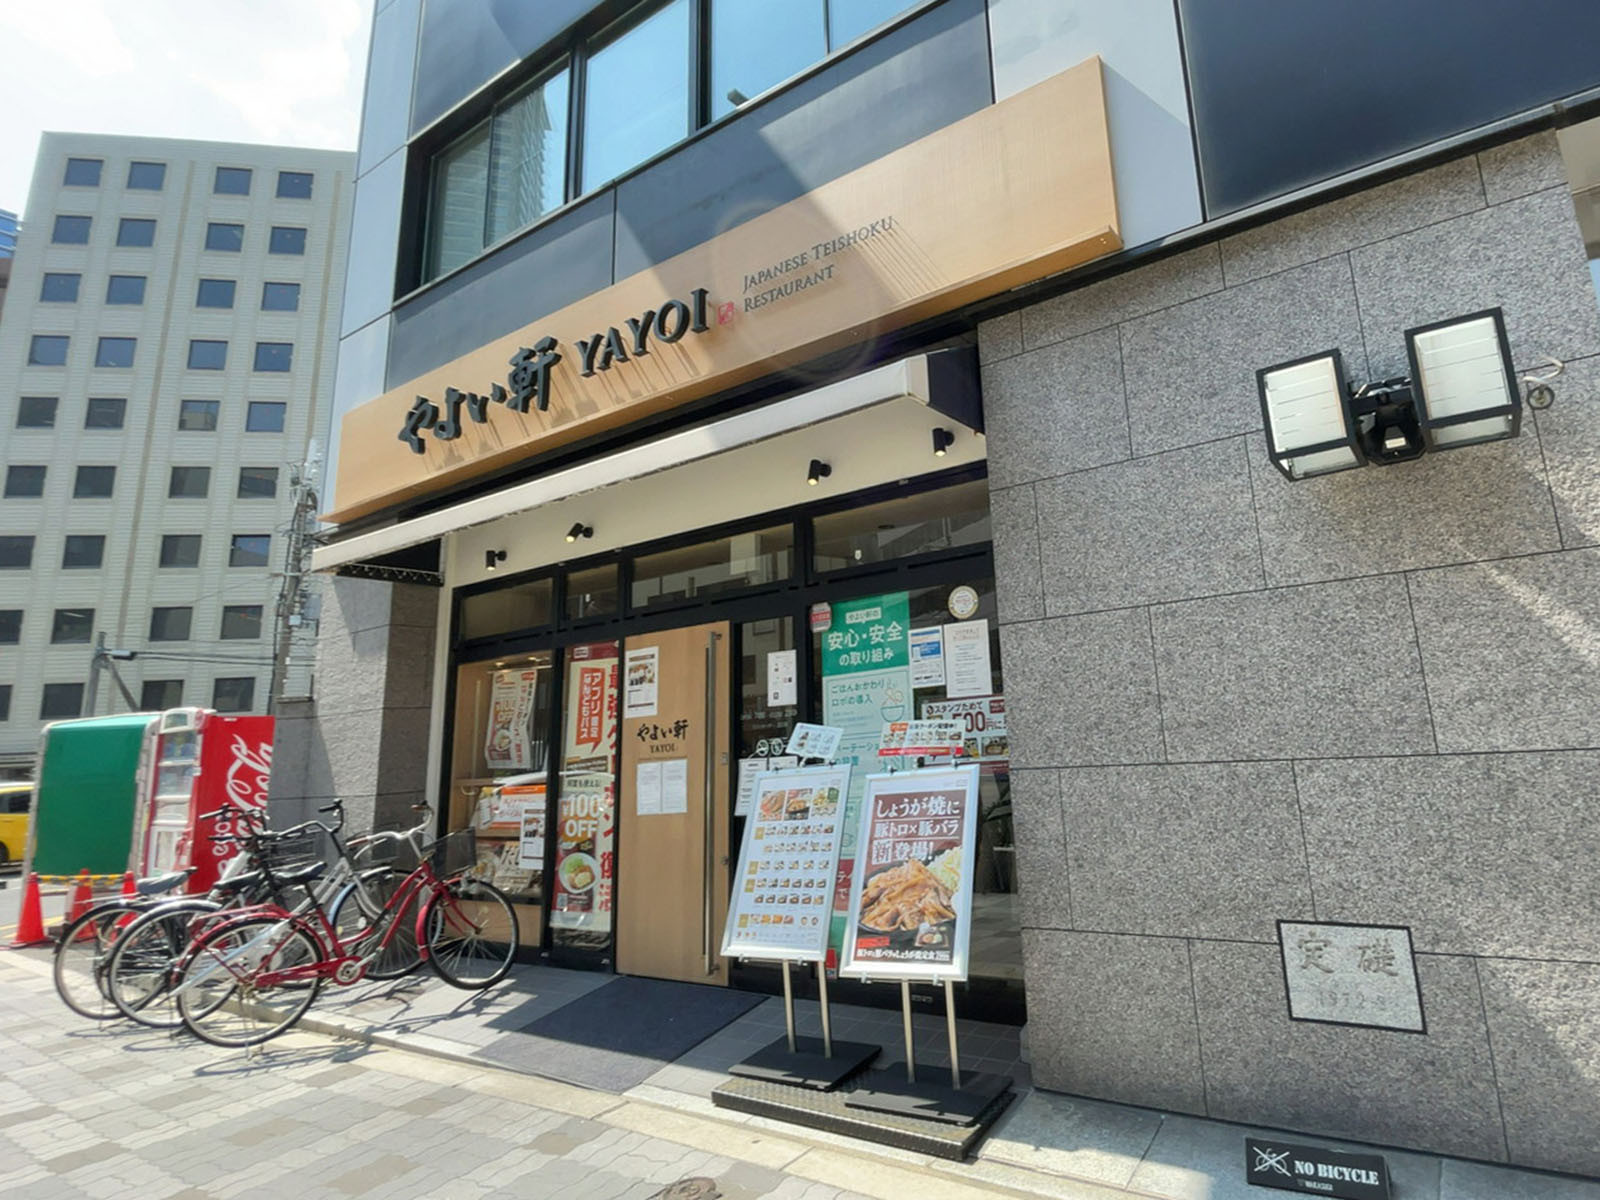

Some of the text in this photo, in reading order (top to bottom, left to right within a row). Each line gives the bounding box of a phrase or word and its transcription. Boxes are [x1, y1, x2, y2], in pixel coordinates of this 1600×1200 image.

[743, 216, 893, 294] JAPANESE TEISHOKU
[743, 264, 835, 312] RESTAURANT
[574, 287, 709, 377] YAYOI
[398, 335, 561, 455] やよい軒
[828, 621, 903, 651] 安心・安全
[839, 647, 895, 665] の取り組み
[637, 719, 689, 742] やよい軒
[877, 795, 960, 818] しょうが焼に
[564, 819, 599, 839] OFF
[1294, 1160, 1379, 1185] NO BICYCLE
